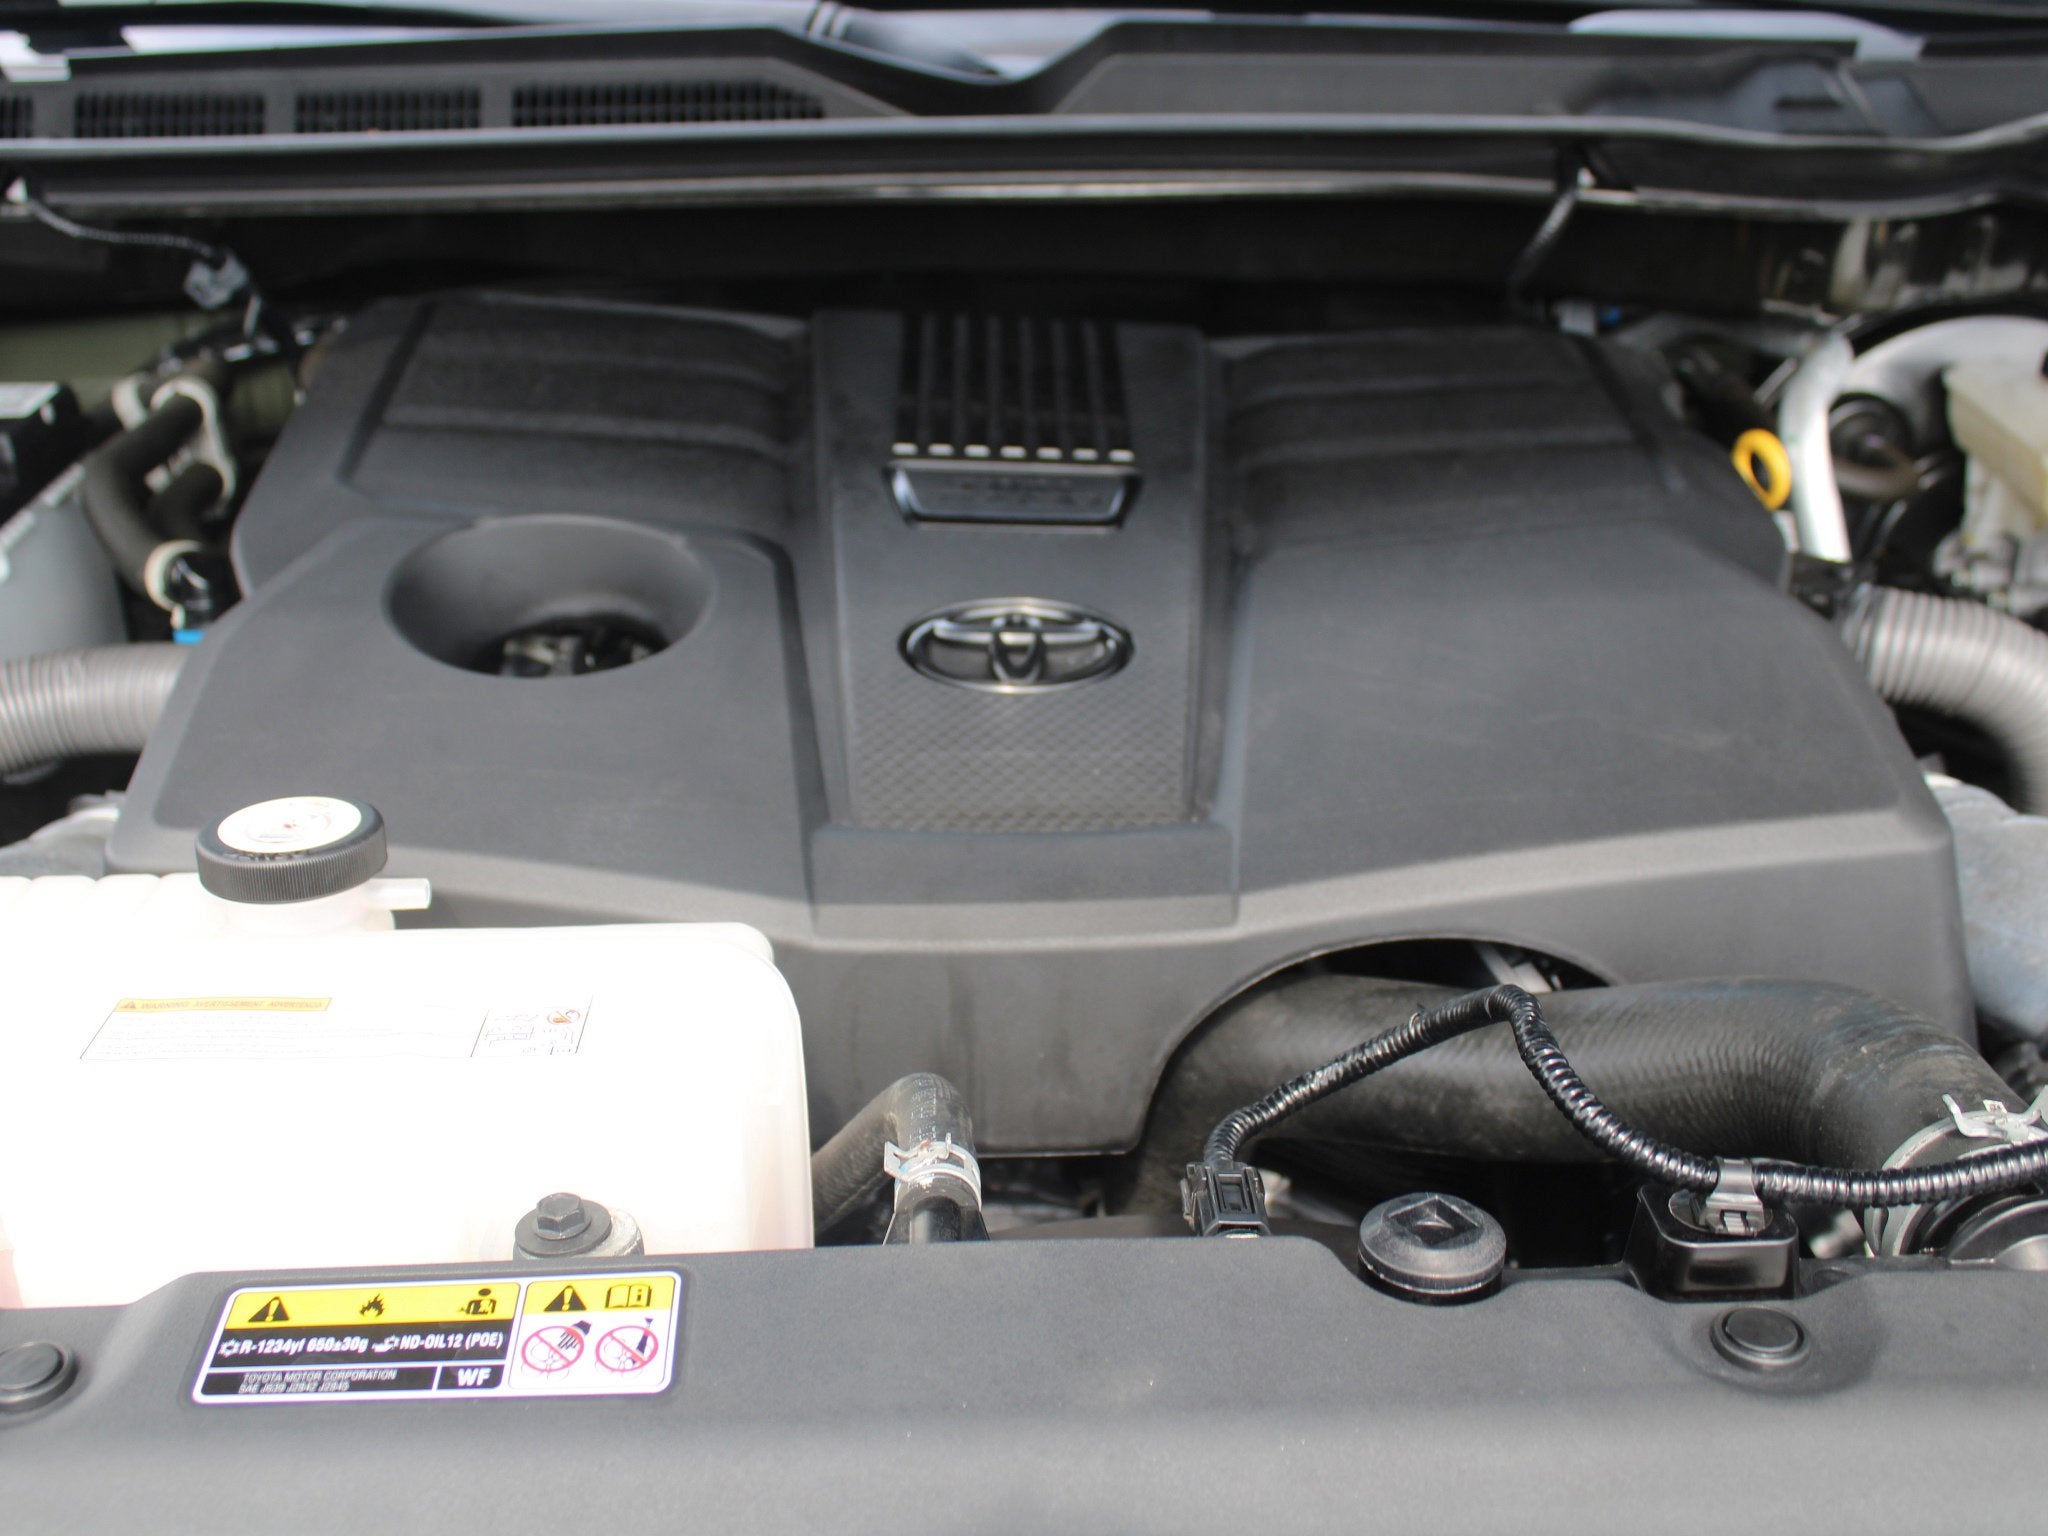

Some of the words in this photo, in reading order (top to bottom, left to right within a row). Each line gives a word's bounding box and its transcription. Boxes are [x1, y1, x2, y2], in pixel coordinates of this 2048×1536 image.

[239, 1337, 306, 1355] R-1234yf
[306, 1336, 369, 1353] 650±30g
[465, 1331, 503, 1350] (POE)
[243, 1371, 283, 1384] TOYOTA
[284, 1370, 323, 1383] MOTOR
[322, 1368, 398, 1381] CORPORATION
[457, 1367, 492, 1387] WF
[238, 1383, 260, 1394] SAE
